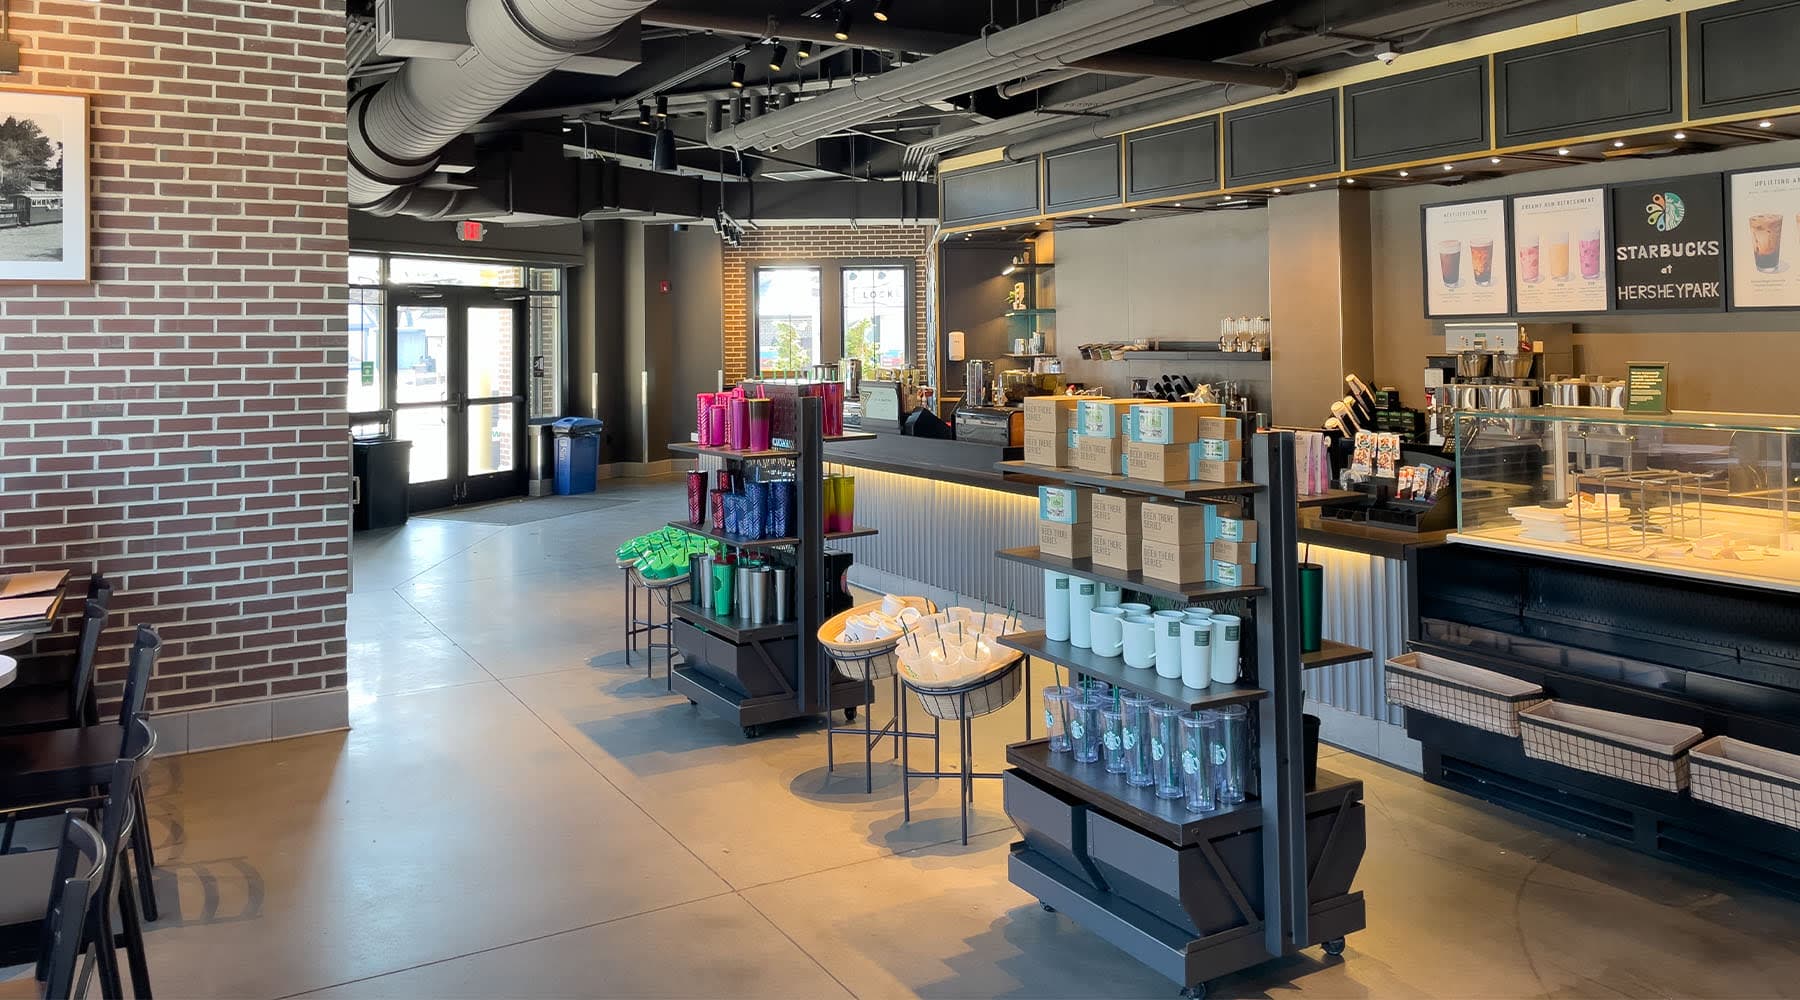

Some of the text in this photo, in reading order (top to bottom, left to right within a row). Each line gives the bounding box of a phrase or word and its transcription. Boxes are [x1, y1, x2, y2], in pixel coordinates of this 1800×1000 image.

[1616, 241, 1720, 260] STARBUCKS
[1660, 264, 1672, 274] at
[1617, 281, 1720, 300] HERSHEYPARK
